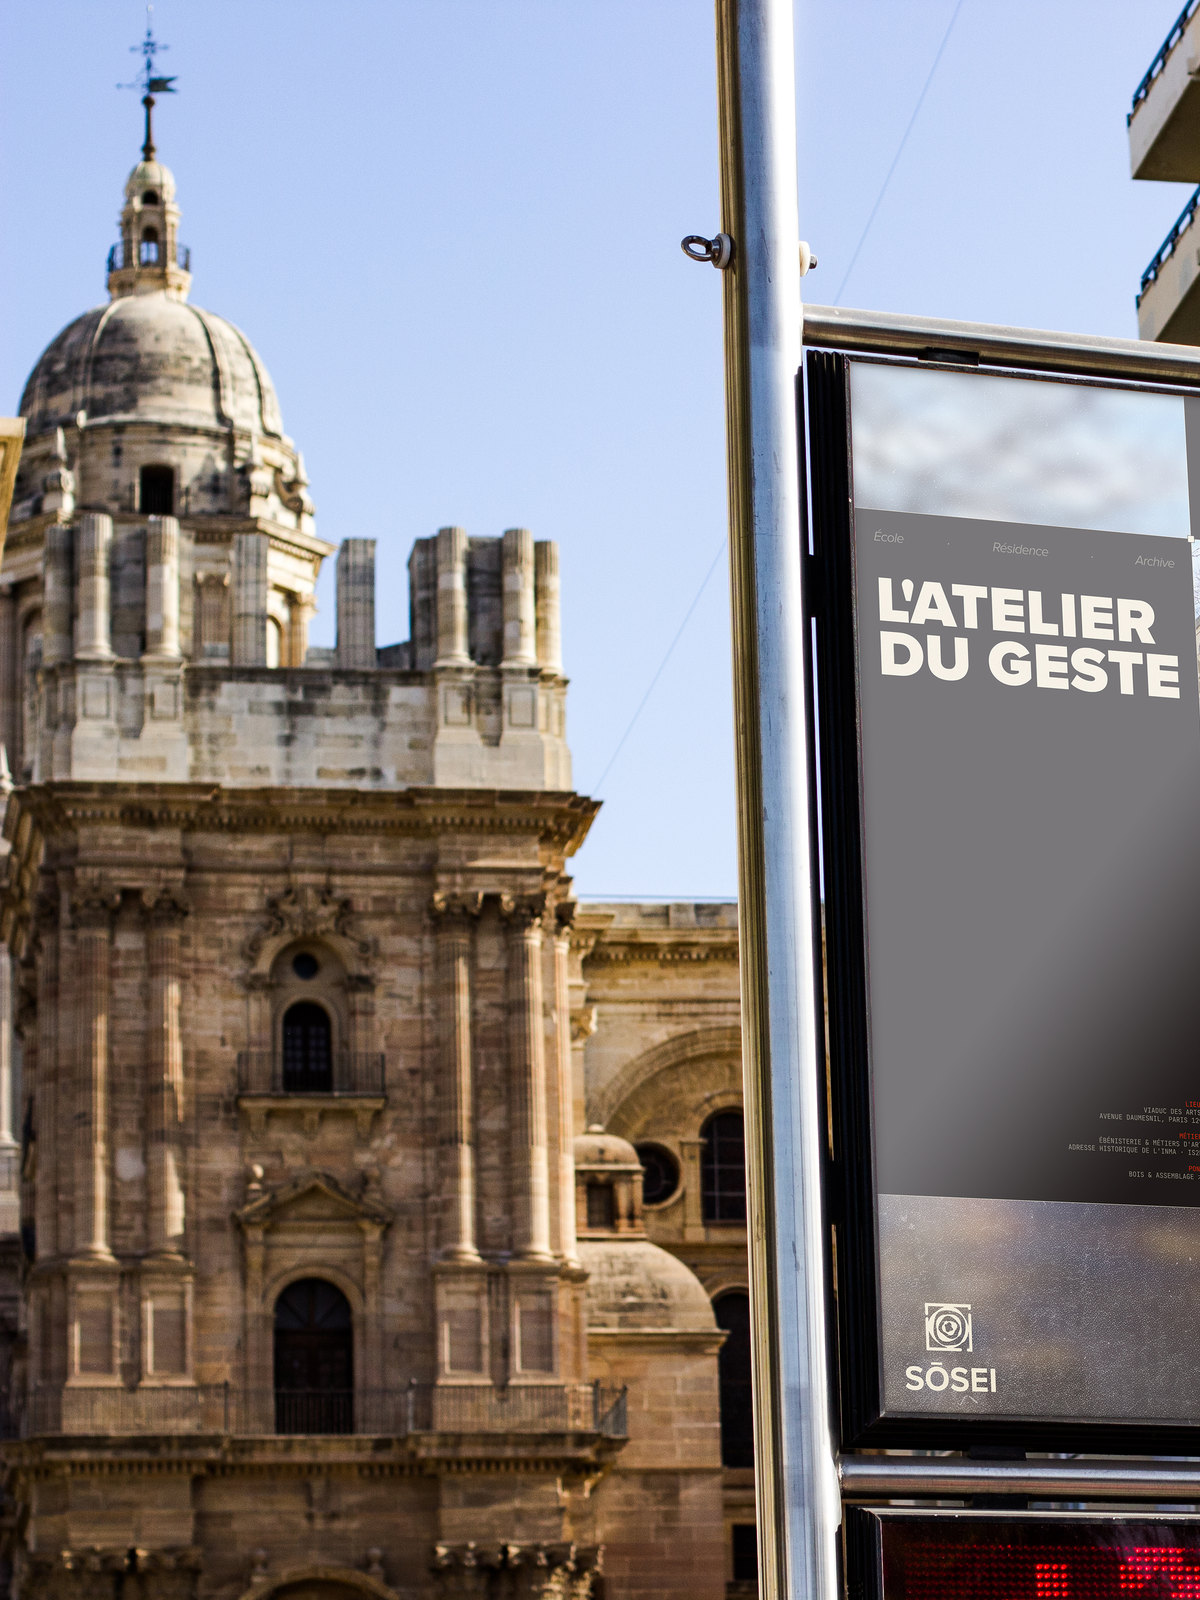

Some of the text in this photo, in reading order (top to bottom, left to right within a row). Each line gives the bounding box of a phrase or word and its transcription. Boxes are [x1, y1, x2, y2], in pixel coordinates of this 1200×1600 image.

[874, 528, 904, 544] École
[992, 542, 1049, 557] Résidence
[1134, 555, 1176, 568] Archive
[878, 577, 1156, 644] L'ATELIER
[880, 630, 1180, 699] DU GESTE
[1126, 1114, 1164, 1123] DAUMESNIL,
[1099, 1136, 1142, 1146] ÉBÉNISTERIE
[1153, 1139, 1180, 1147] MÉTIERS
[1100, 1145, 1138, 1154] HISTORIQUE
[1155, 1172, 1194, 1180] ASSEMBLAGE
[905, 1362, 996, 1392] SŌSEI
